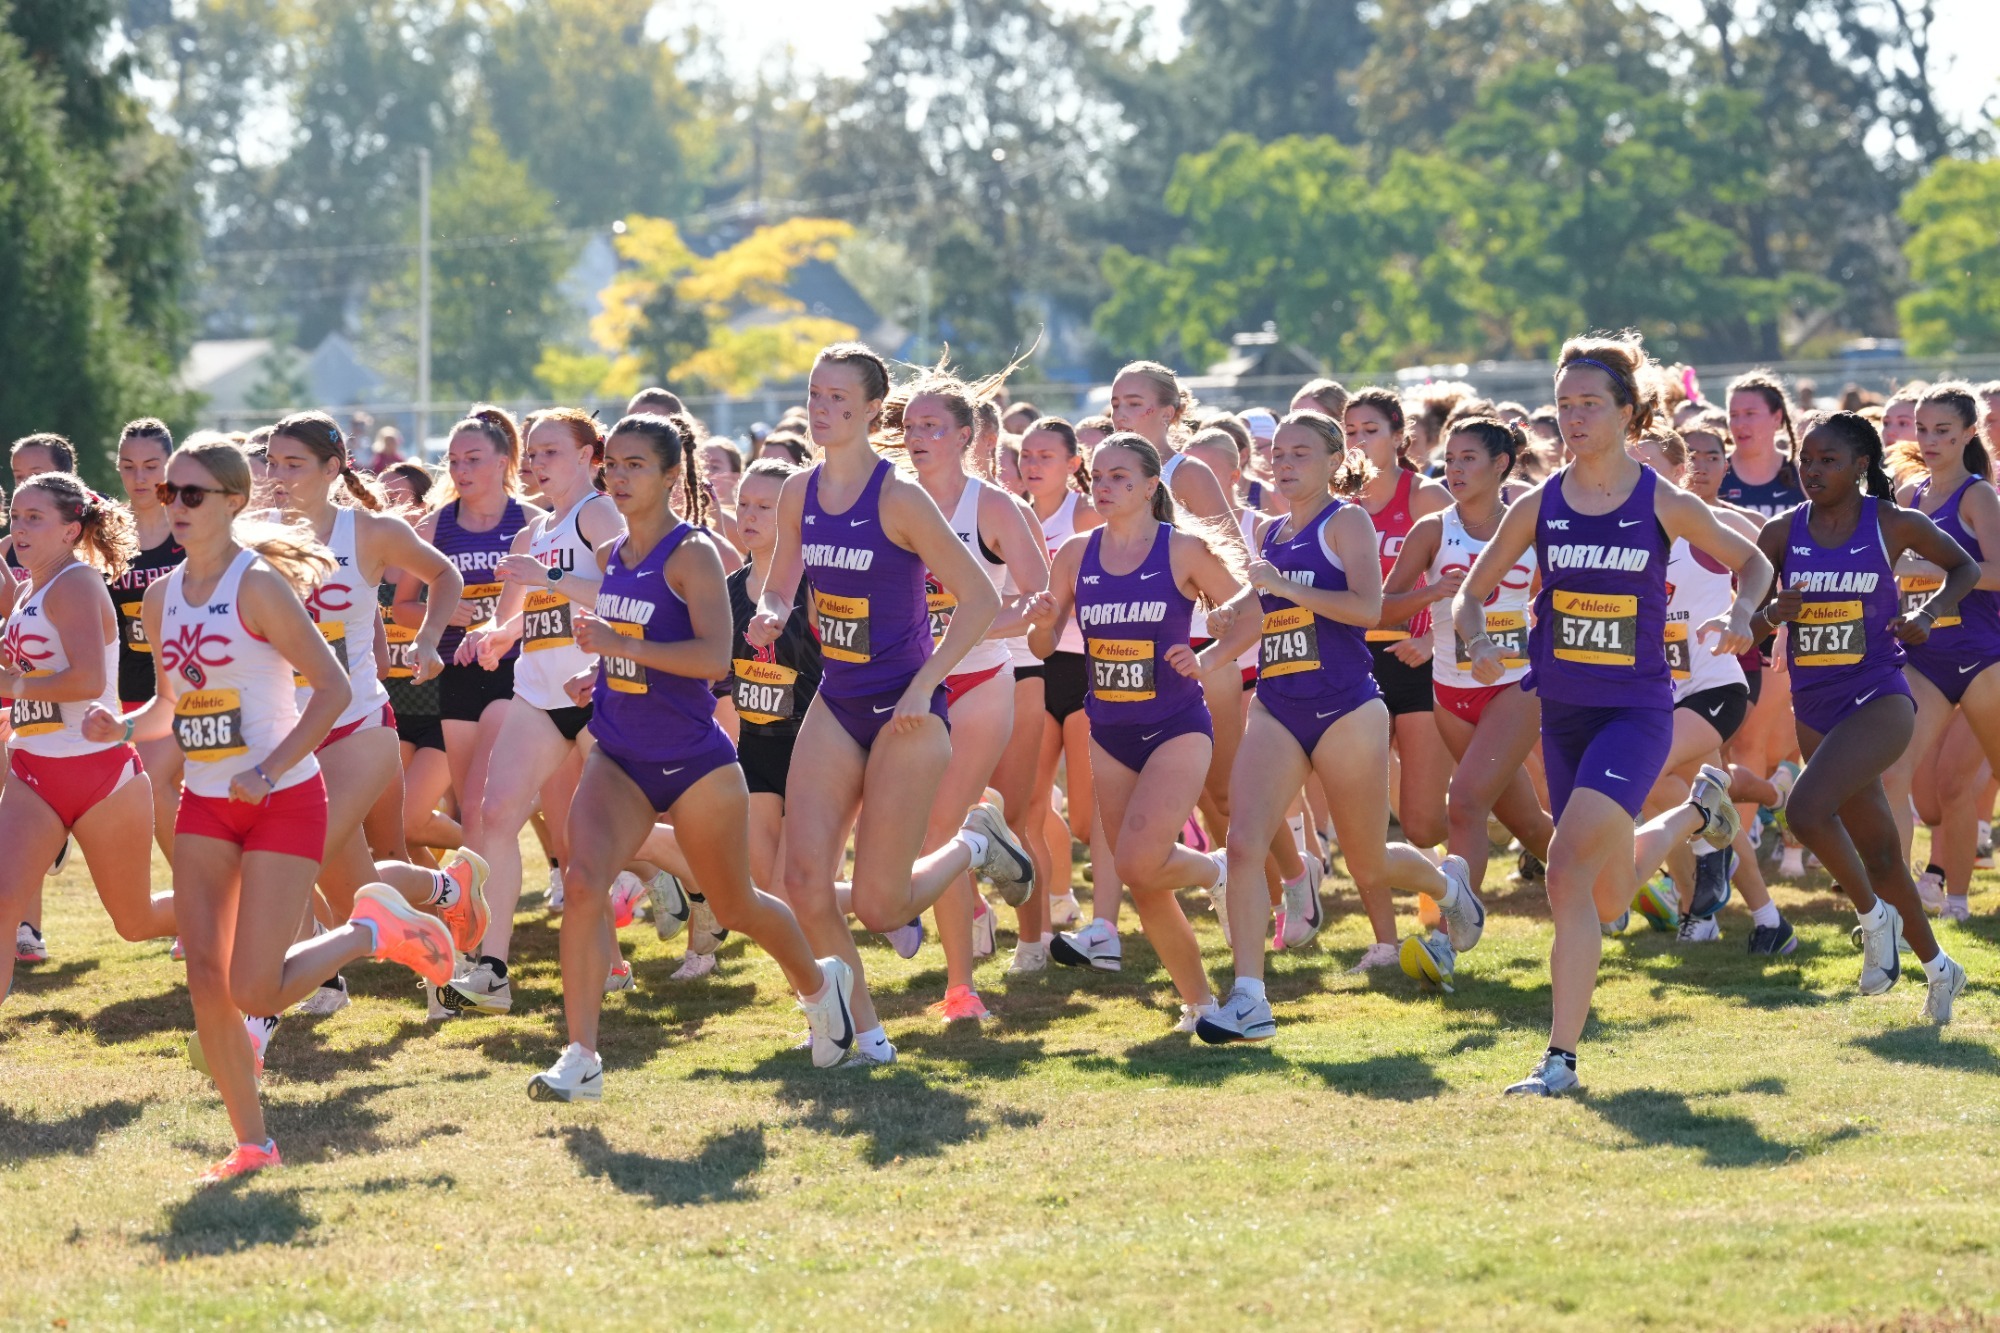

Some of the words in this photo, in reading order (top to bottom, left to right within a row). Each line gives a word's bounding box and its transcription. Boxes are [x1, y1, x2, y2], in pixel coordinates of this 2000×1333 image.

[1546, 520, 1570, 529] WCC
[801, 543, 874, 571] PORTLAND
[1548, 544, 1650, 572] PORTLAND
[1790, 571, 1879, 593] PORTLAND
[819, 598, 854, 614] Athletic
[1081, 602, 1168, 630] PORTLAND
[1566, 598, 1621, 613] Athletic
[1801, 608, 1848, 619] Athletic
[525, 609, 563, 639] 5793
[818, 615, 858, 648] 5747
[1266, 615, 1300, 629] Athletic
[1563, 617, 1622, 649] 5741
[1097, 644, 1139, 656] Athletic
[1264, 631, 1308, 663] 5749
[1798, 625, 1854, 652] 5737
[744, 665, 782, 680] Athletic
[1094, 662, 1144, 688] 5738
[182, 695, 225, 710] Athletic
[738, 682, 784, 712] 5807
[179, 715, 232, 747] 5836
